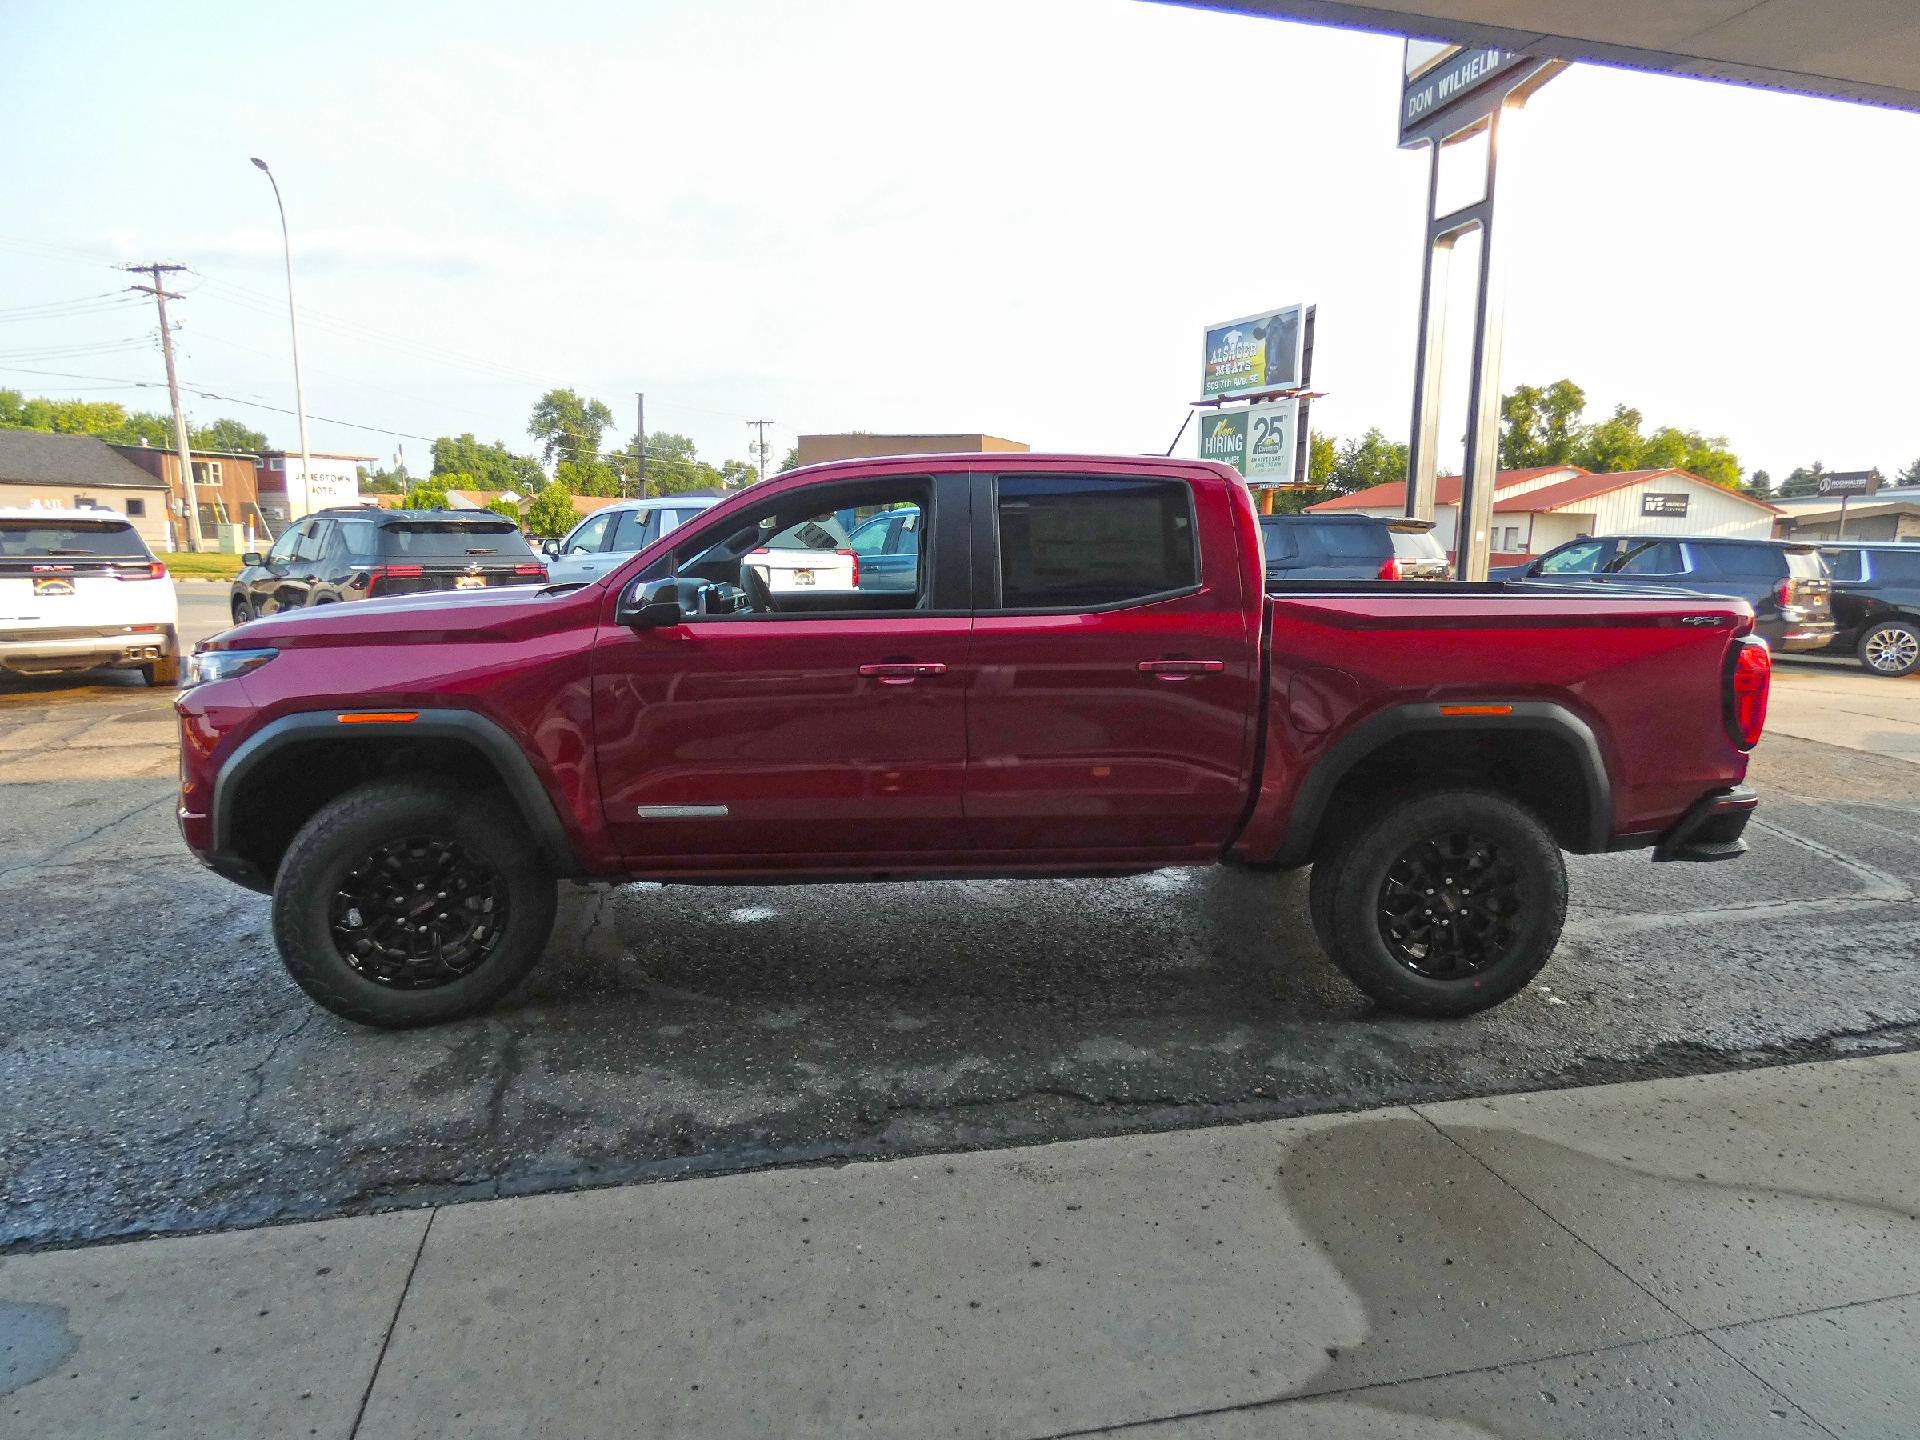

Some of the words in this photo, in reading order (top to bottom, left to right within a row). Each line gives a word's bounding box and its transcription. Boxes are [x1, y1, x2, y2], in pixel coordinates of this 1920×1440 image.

[1408, 85, 1433, 118] DON
[1438, 49, 1499, 99] WILHELM
[1215, 361, 1251, 376] MEATS
[1205, 433, 1243, 454] HIRING
